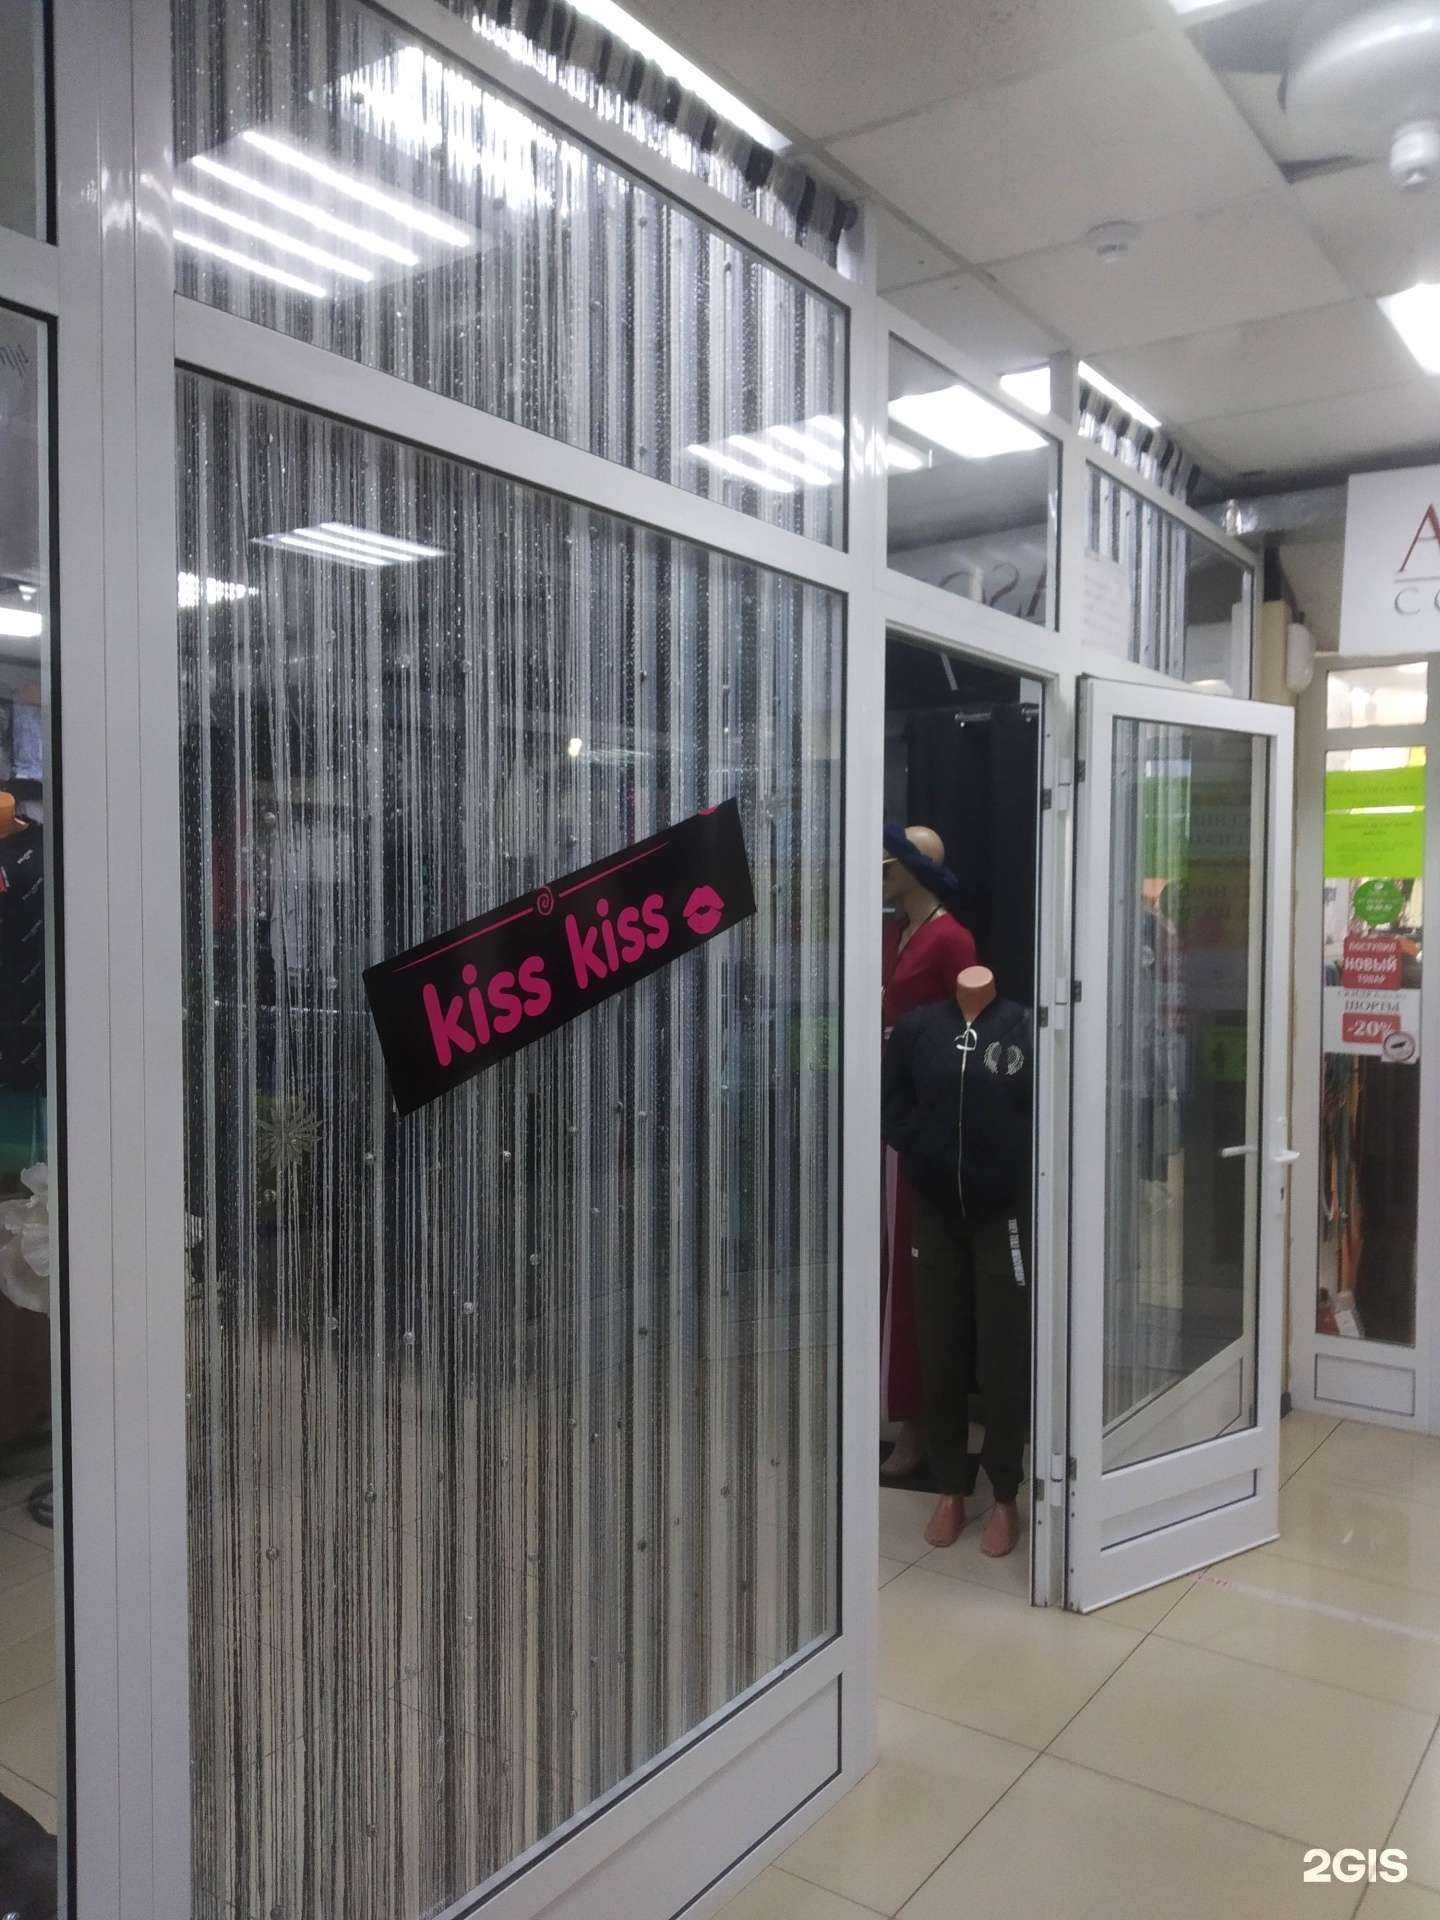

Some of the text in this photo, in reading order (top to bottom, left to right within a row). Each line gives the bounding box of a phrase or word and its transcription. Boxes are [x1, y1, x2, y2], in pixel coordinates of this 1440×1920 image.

[1394, 586, 1440, 616] C
[1344, 954, 1398, 972] НОВЫЙ
[422, 894, 669, 1067] kiss kiss
